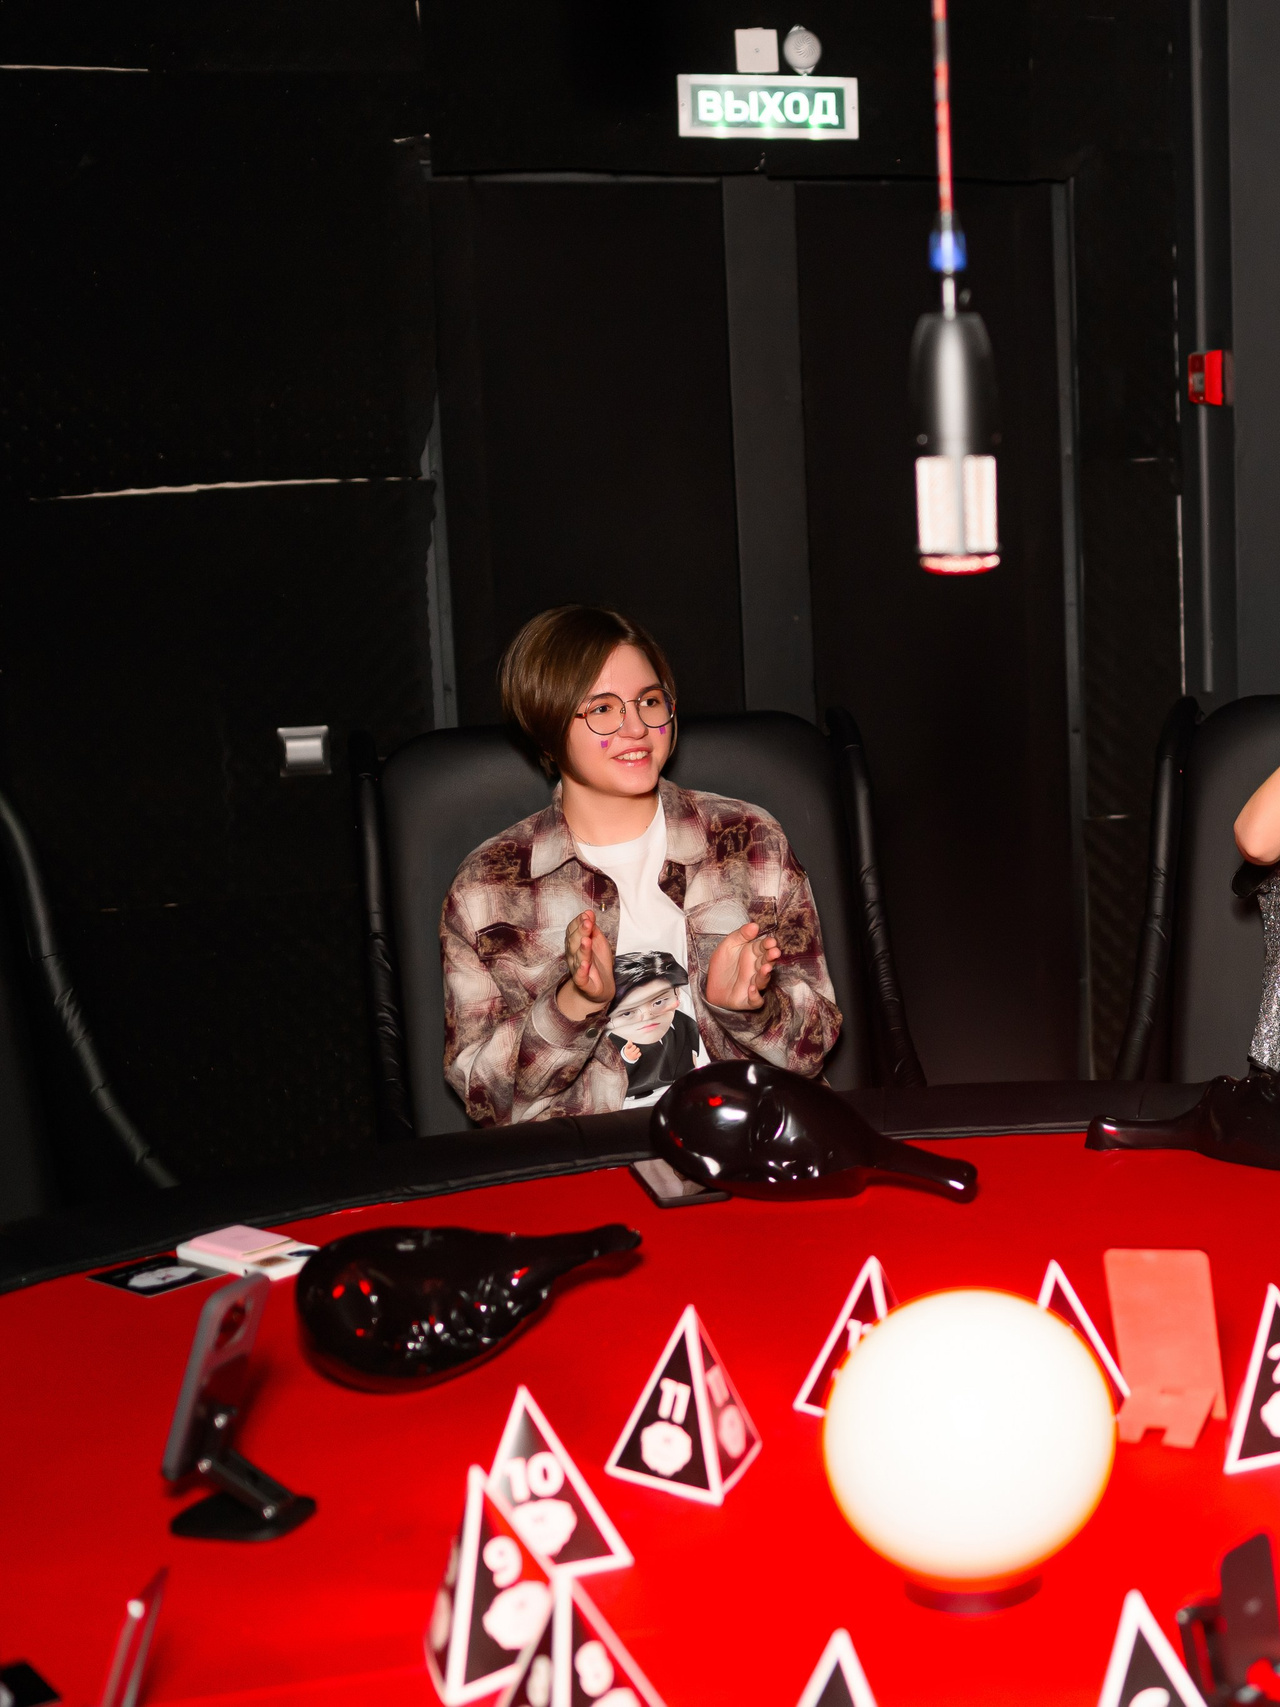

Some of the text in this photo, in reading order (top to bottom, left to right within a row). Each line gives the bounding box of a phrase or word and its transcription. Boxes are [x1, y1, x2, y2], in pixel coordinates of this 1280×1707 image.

[698, 90, 839, 125] ВЫХОД
[658, 1377, 692, 1425] 11
[505, 1451, 565, 1502] 10
[483, 1535, 523, 1588] 9
